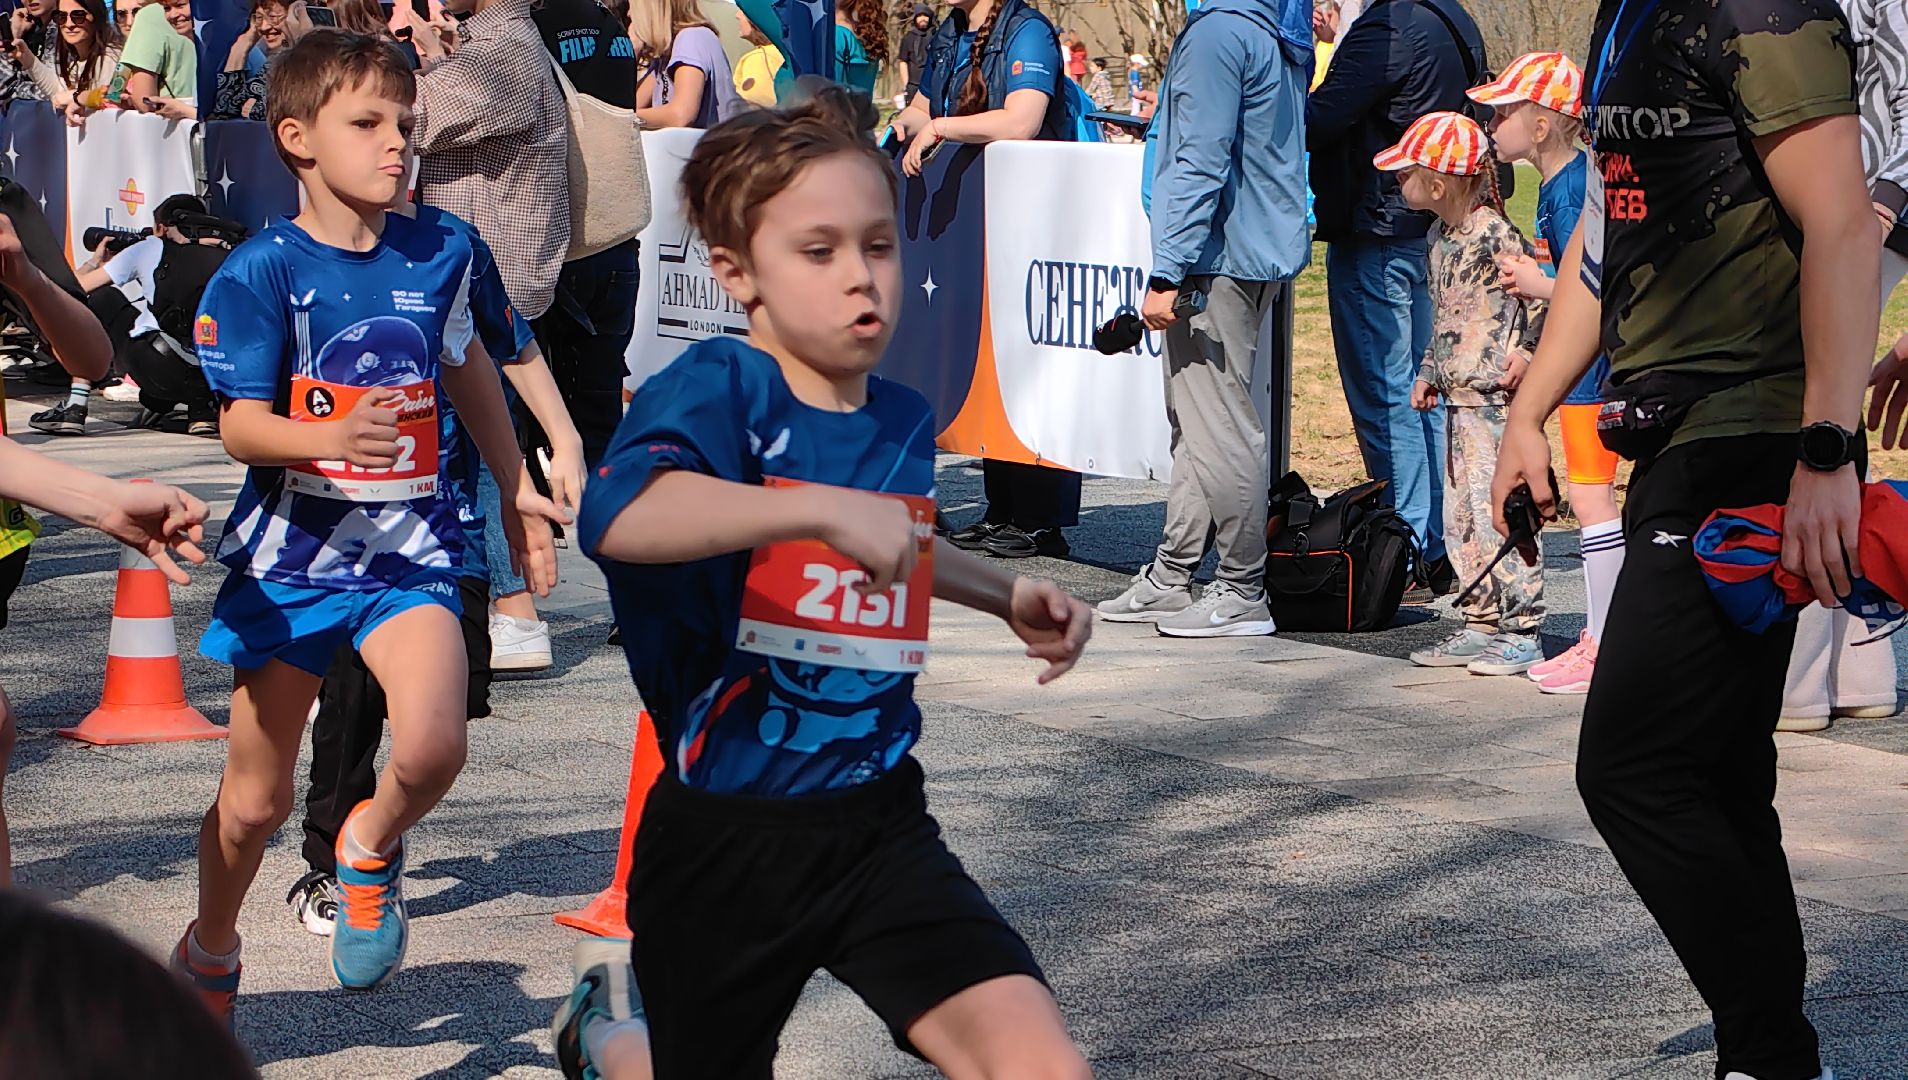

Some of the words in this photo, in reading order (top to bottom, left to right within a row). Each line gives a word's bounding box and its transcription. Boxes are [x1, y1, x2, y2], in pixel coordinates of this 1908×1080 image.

[559, 36, 595, 64] FILM
[607, 36, 634, 59] REW
[662, 272, 720, 311] AHMAD
[690, 320, 722, 334] LONDON
